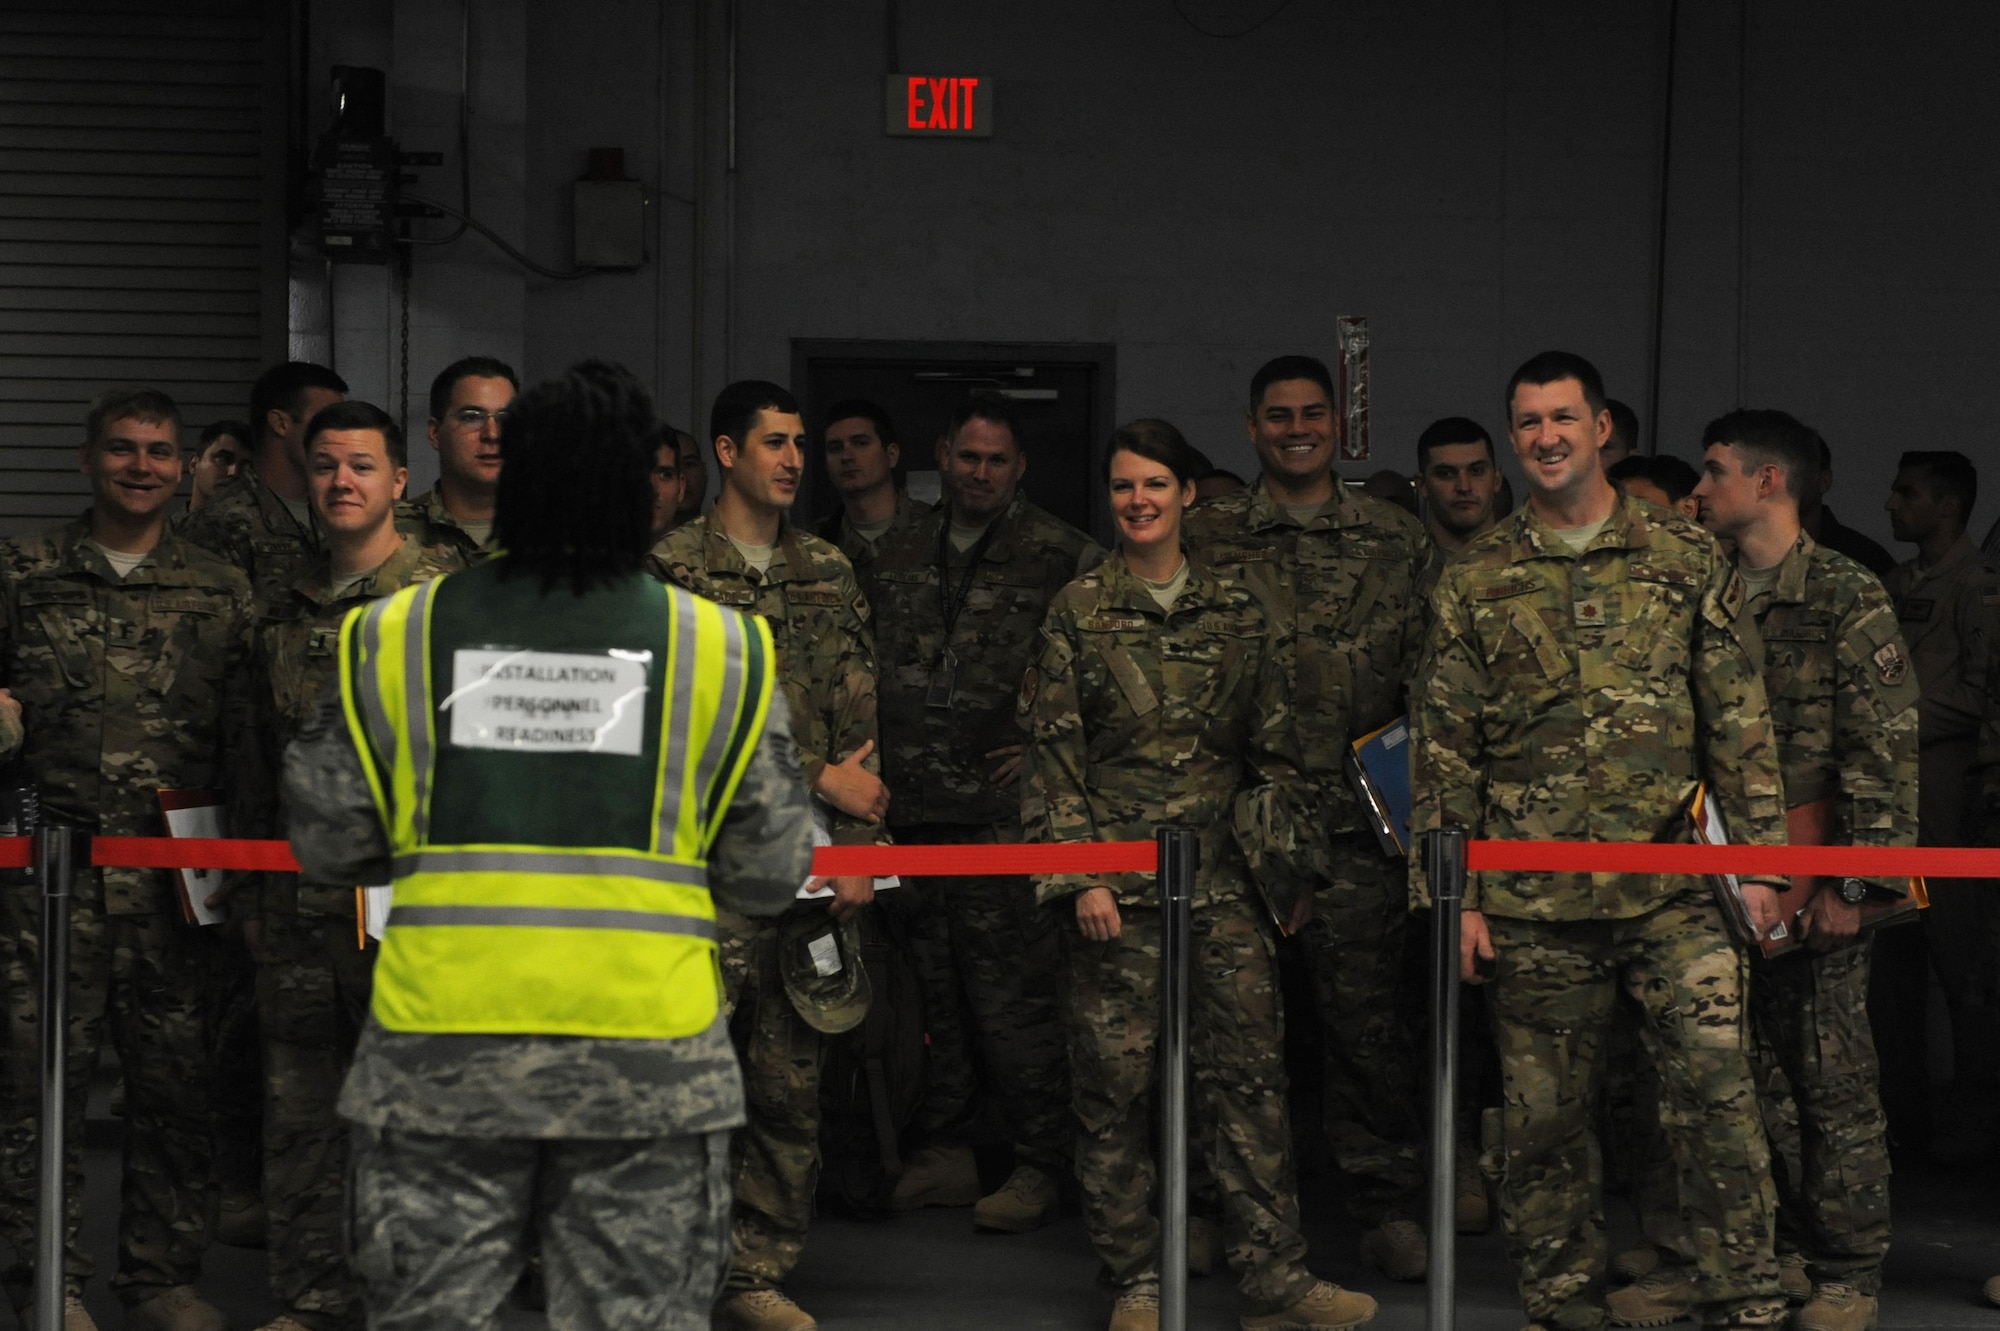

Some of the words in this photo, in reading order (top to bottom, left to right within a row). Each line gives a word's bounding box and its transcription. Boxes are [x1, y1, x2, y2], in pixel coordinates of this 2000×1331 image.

[907, 76, 979, 130] EXIT
[492, 695, 601, 713] PERSONNEL
[495, 726, 596, 742] READINESS
